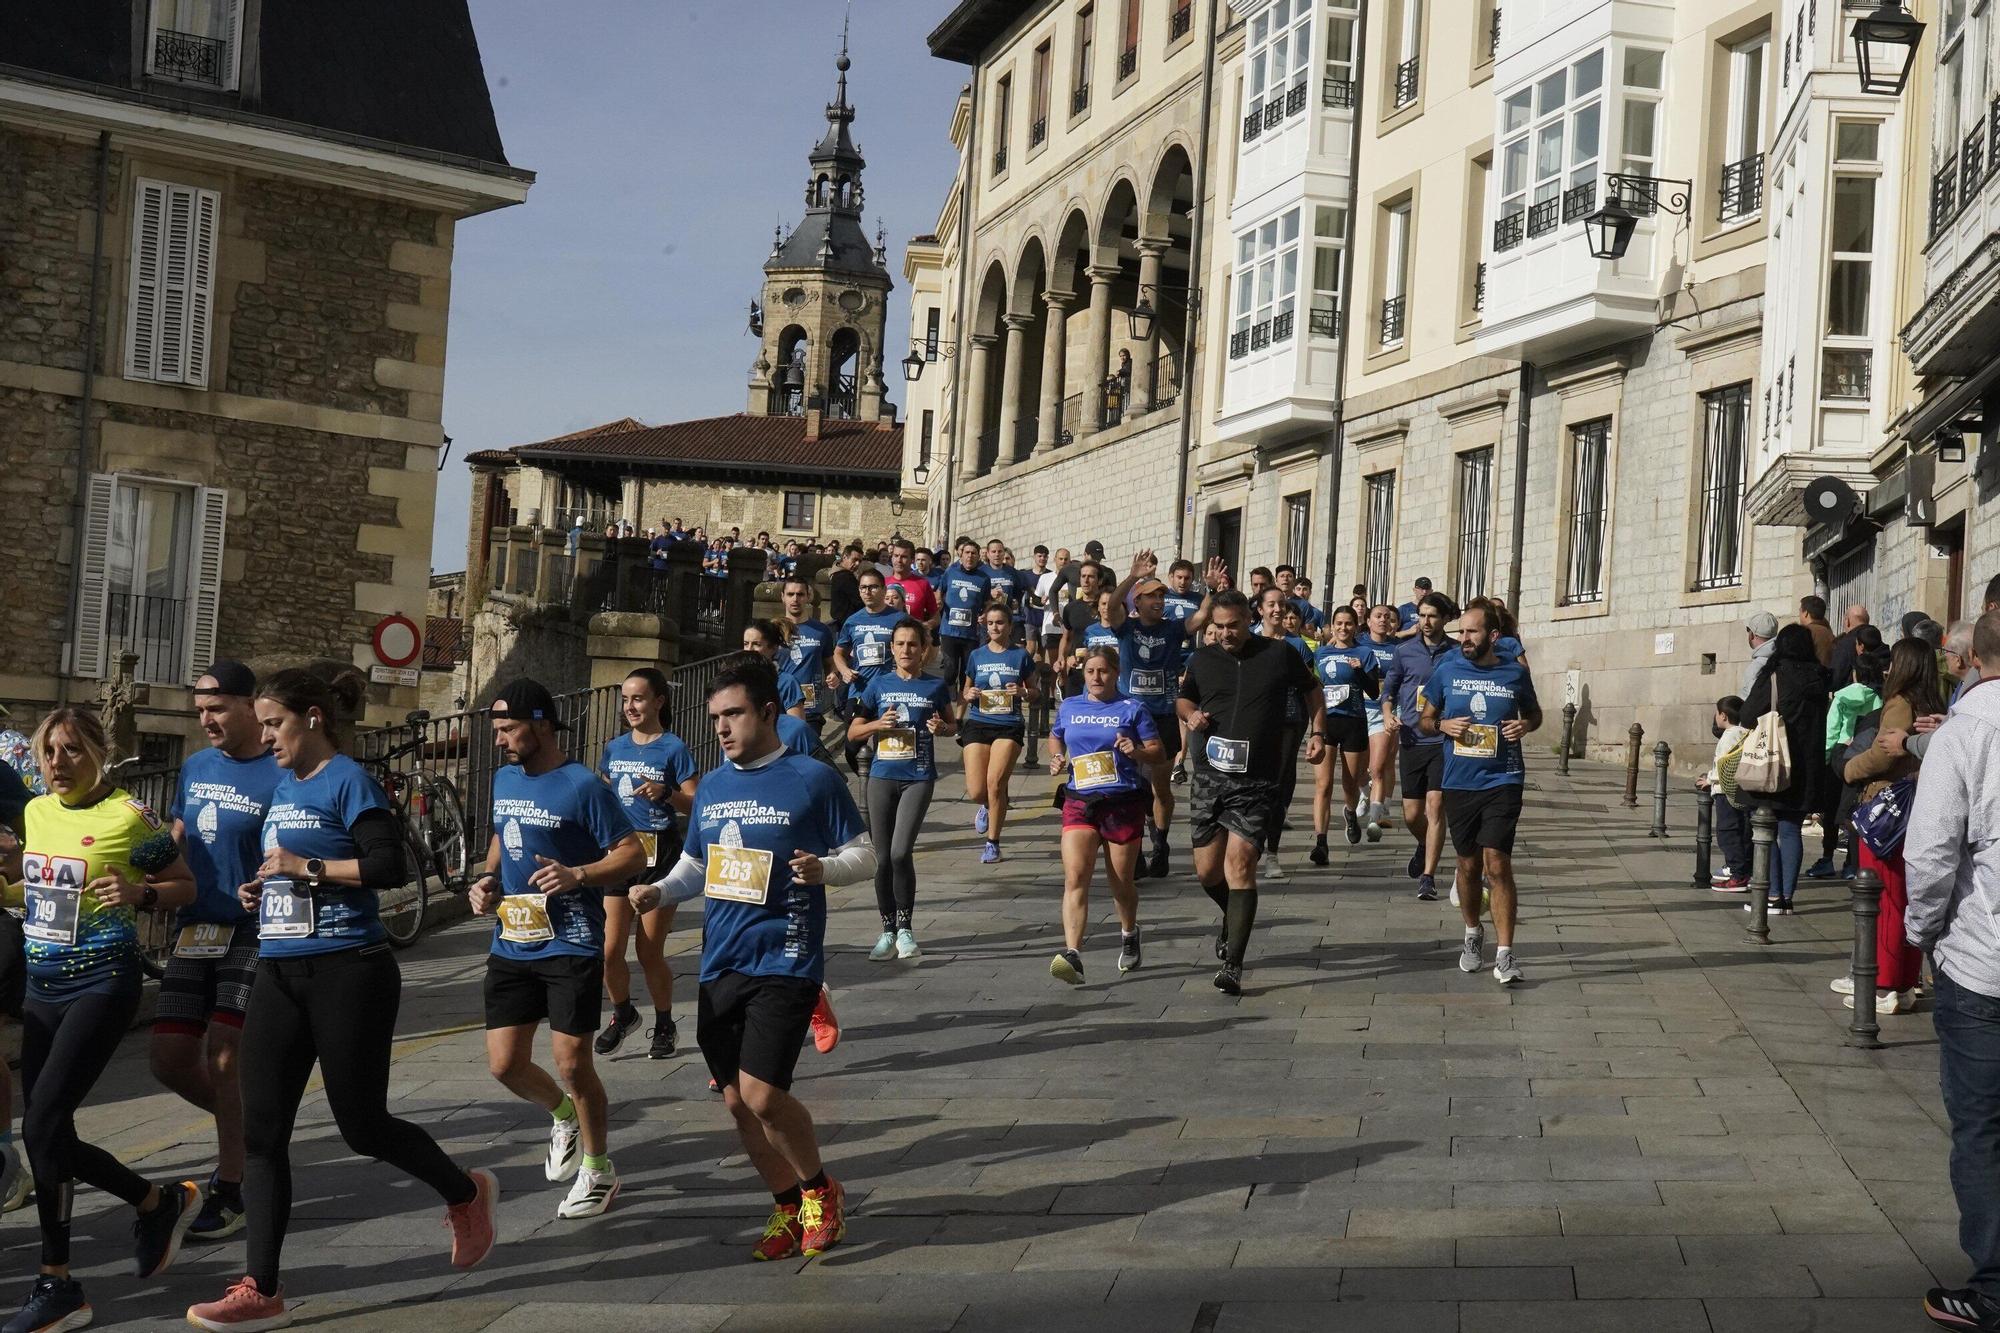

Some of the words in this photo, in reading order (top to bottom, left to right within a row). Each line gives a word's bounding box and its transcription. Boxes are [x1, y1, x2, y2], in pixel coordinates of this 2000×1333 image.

[1938, 546, 1944, 557] 2
[1217, 746, 1235, 760] 774
[612, 765, 656, 774] ALMENDRA
[1086, 760, 1102, 775] 53
[197, 783, 236, 794] CONQUISTA
[194, 789, 250, 806] ALMENDRA
[219, 801, 261, 816] KONKISTA
[711, 800, 757, 810] CONQUISTA
[496, 806, 549, 819] ALMENDRA
[709, 806, 776, 820] ALMENDRA
[278, 820, 321, 829] KONKISTA
[520, 816, 561, 829] KONKISTA
[741, 816, 790, 825] KONKISTA
[719, 859, 752, 881] 263
[34, 899, 56, 922] 749
[265, 895, 293, 917] 828
[507, 907, 533, 925] 522
